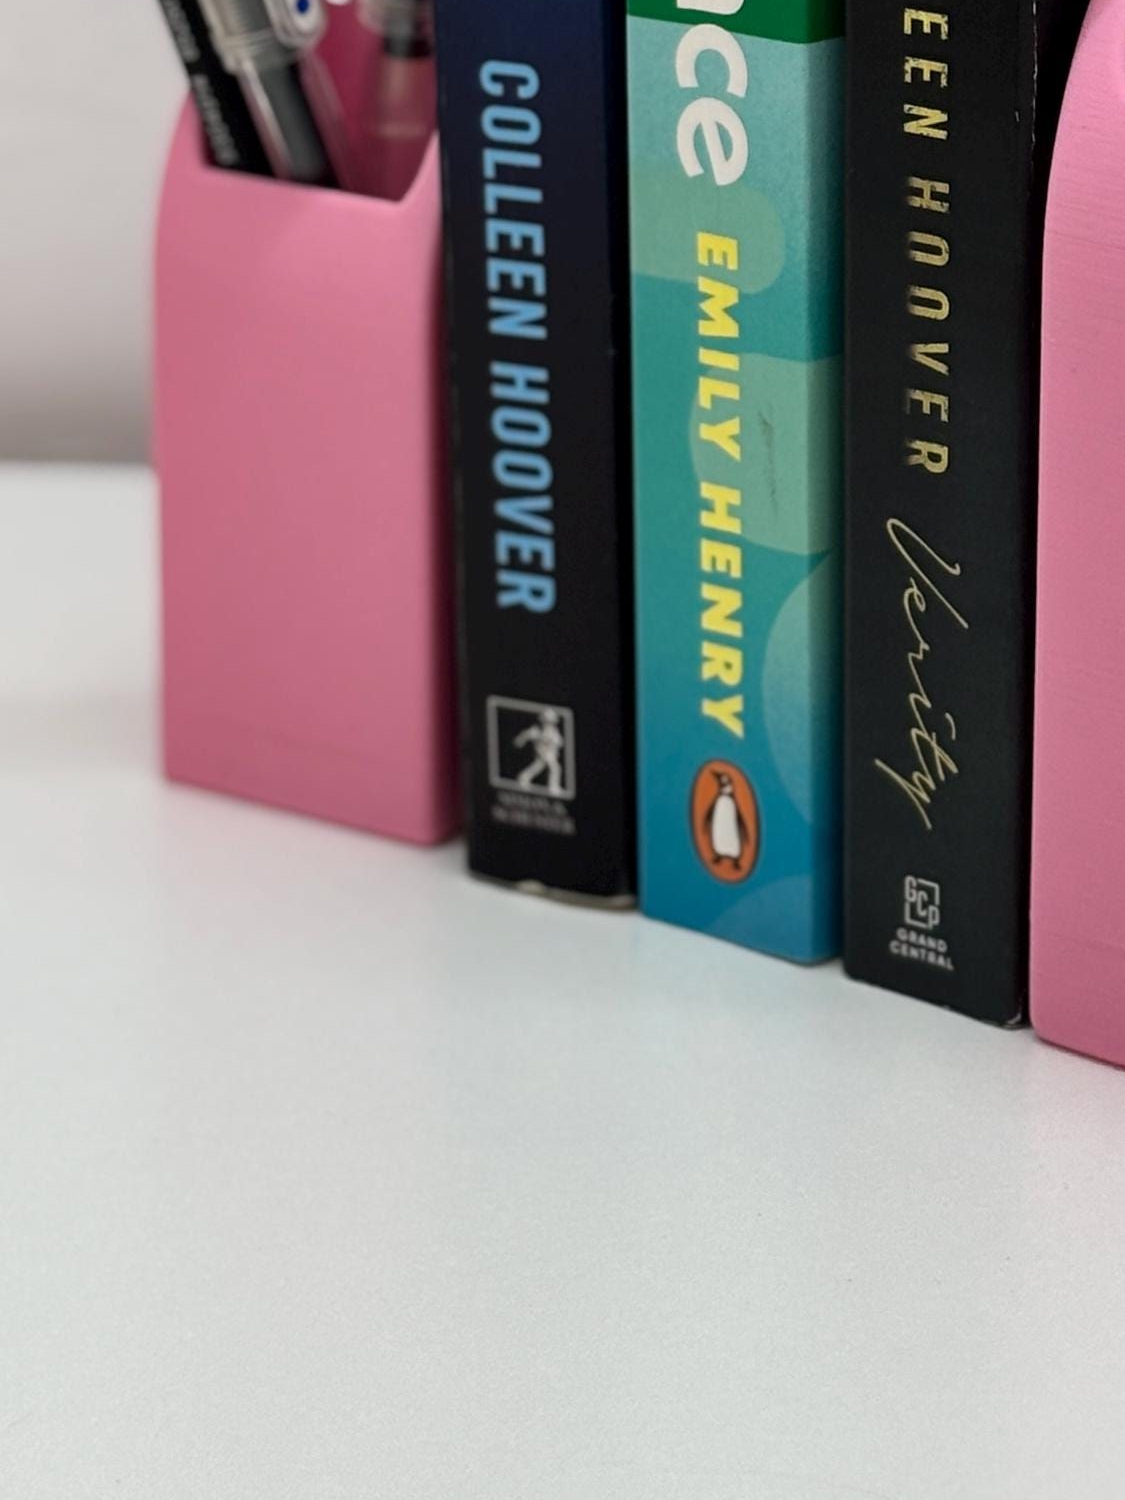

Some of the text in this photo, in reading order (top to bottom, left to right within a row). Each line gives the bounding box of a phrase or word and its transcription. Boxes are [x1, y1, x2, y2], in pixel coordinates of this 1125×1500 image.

[479, 58, 557, 614] COLLEEN HOOVER
[904, 175, 951, 475] HOOVER
[697, 230, 744, 739] EMILY HENRY
[874, 517, 969, 831] Verity
[889, 939, 955, 971] CENTRAL
[895, 926, 948, 953] GRAND
